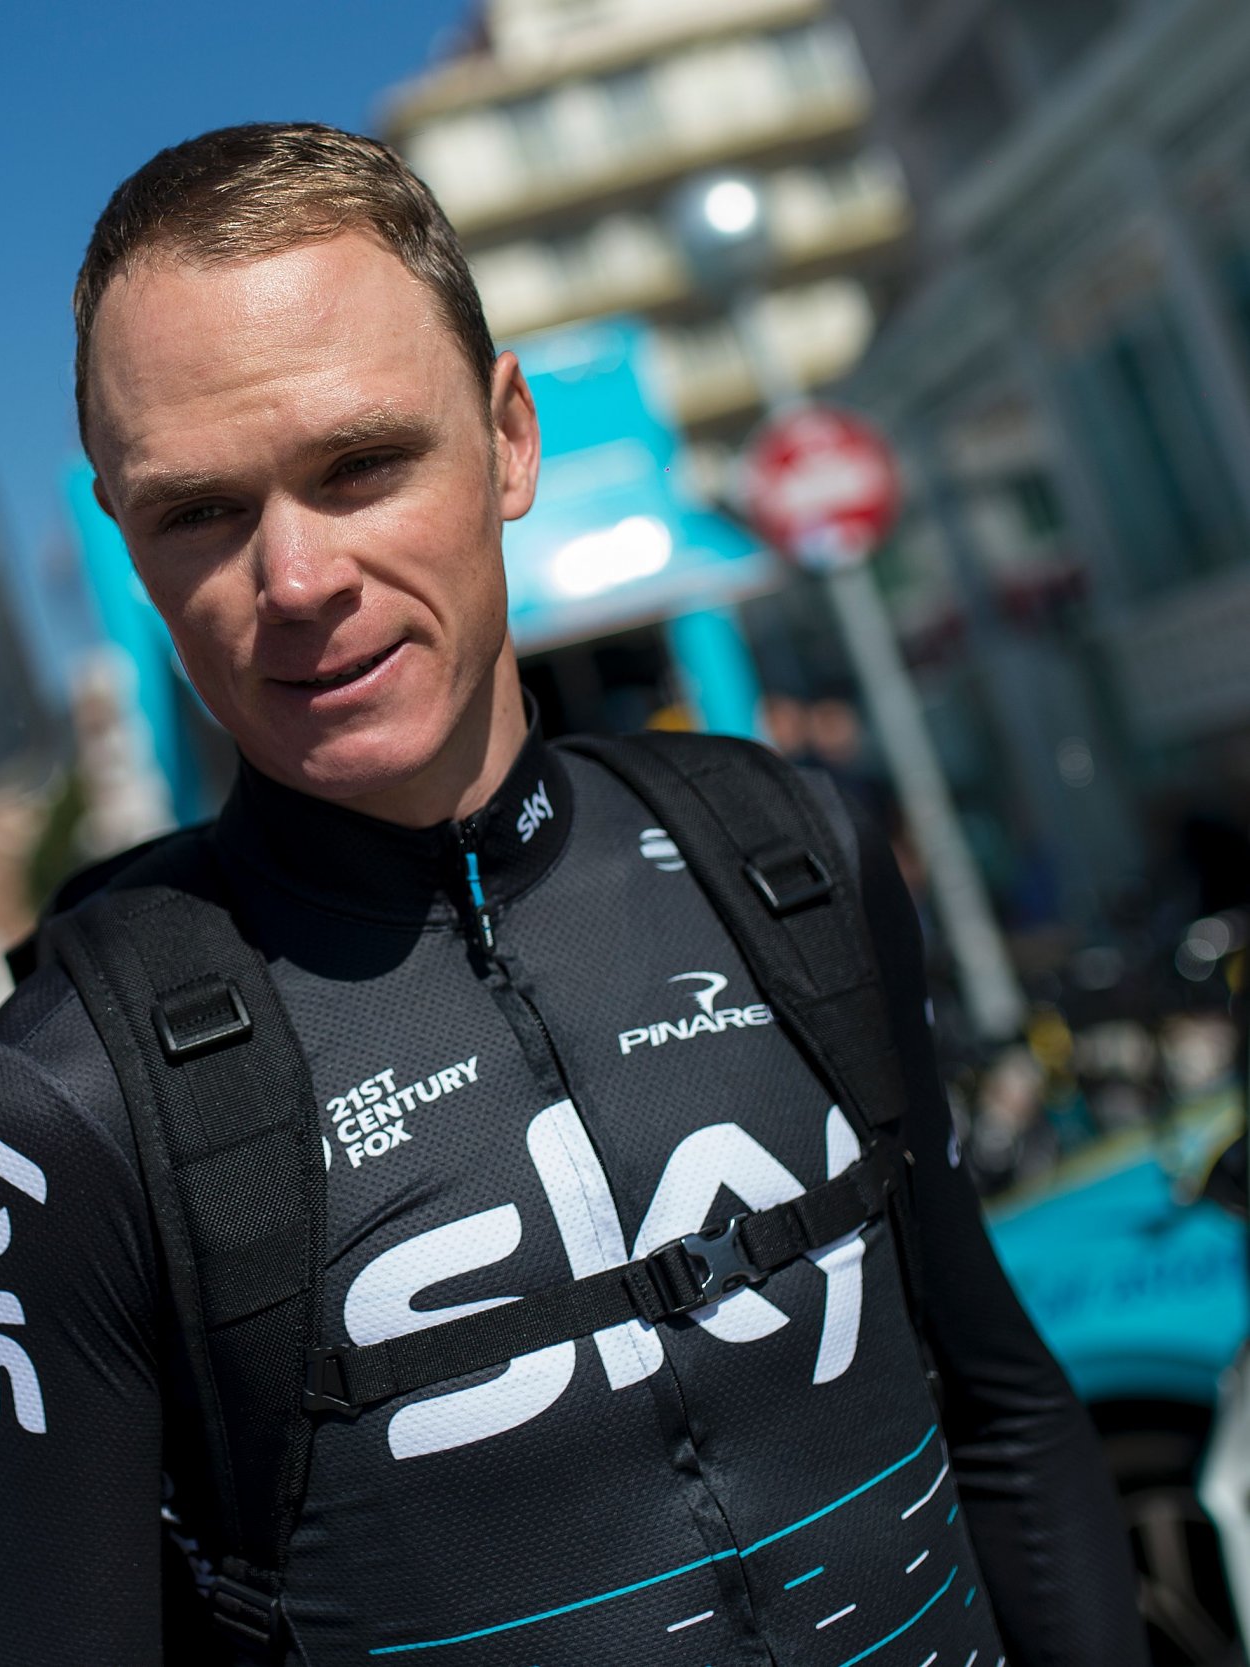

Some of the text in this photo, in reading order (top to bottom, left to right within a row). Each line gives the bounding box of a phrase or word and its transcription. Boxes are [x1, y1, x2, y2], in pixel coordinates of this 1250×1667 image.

[618, 1003, 774, 1055] PINARE
[326, 1068, 396, 1123] 21ST
[337, 1055, 478, 1143] CENTURY
[345, 1119, 413, 1169] FOX
